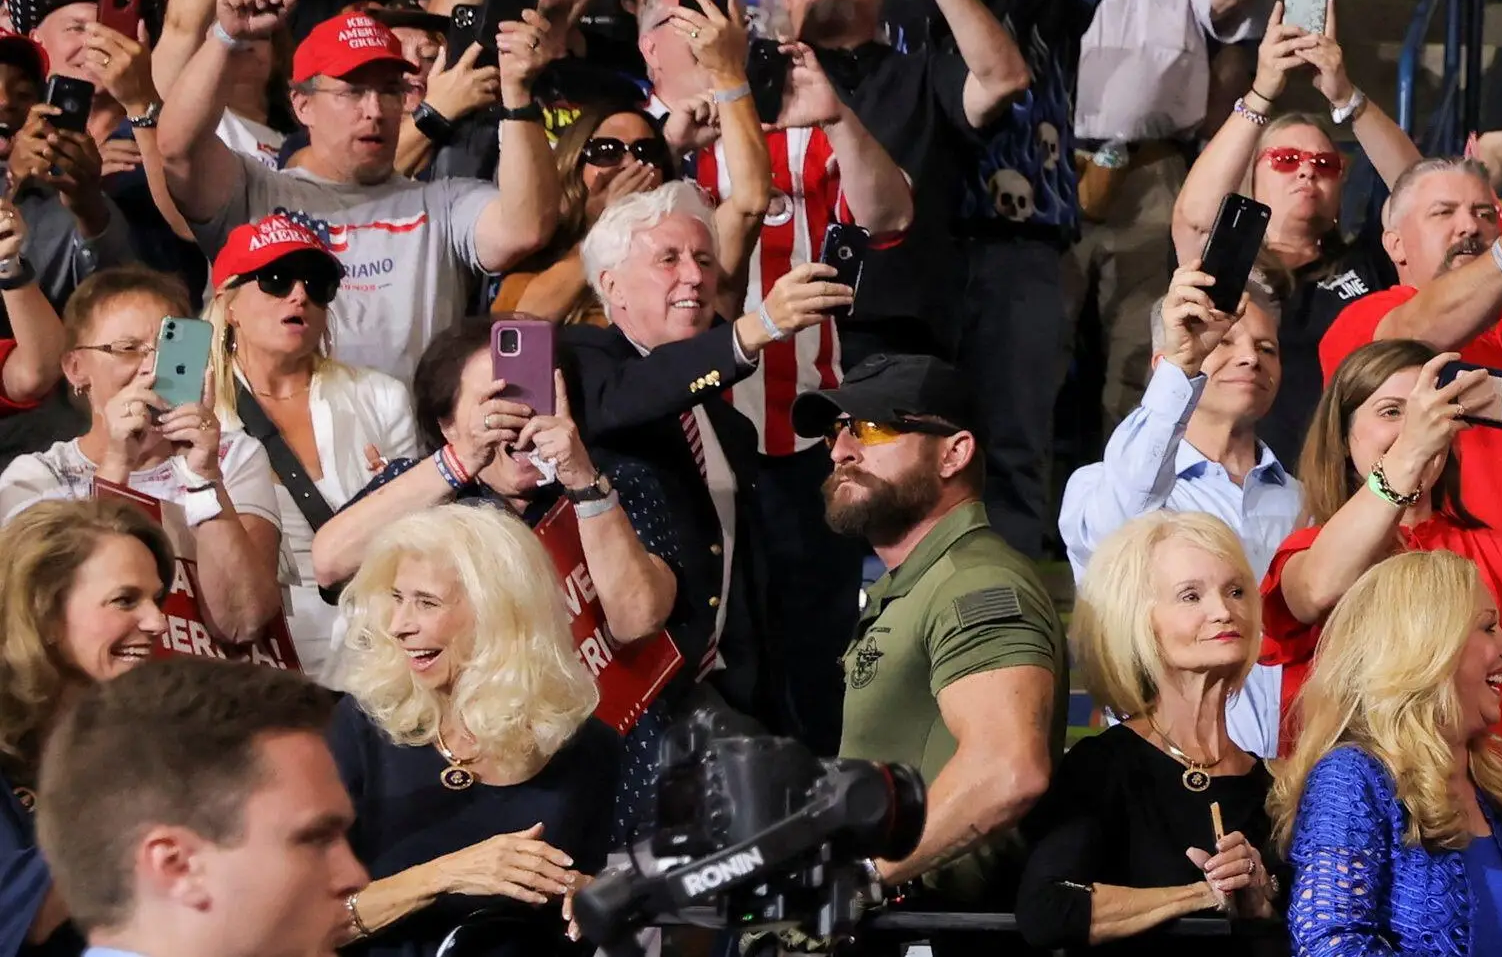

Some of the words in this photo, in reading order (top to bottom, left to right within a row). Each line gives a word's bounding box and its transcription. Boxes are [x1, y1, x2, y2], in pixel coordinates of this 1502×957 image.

[260, 218, 291, 234] SAV
[343, 258, 394, 280] RIANO
[1338, 278, 1370, 300] LINE
[682, 846, 764, 897] RONIN
